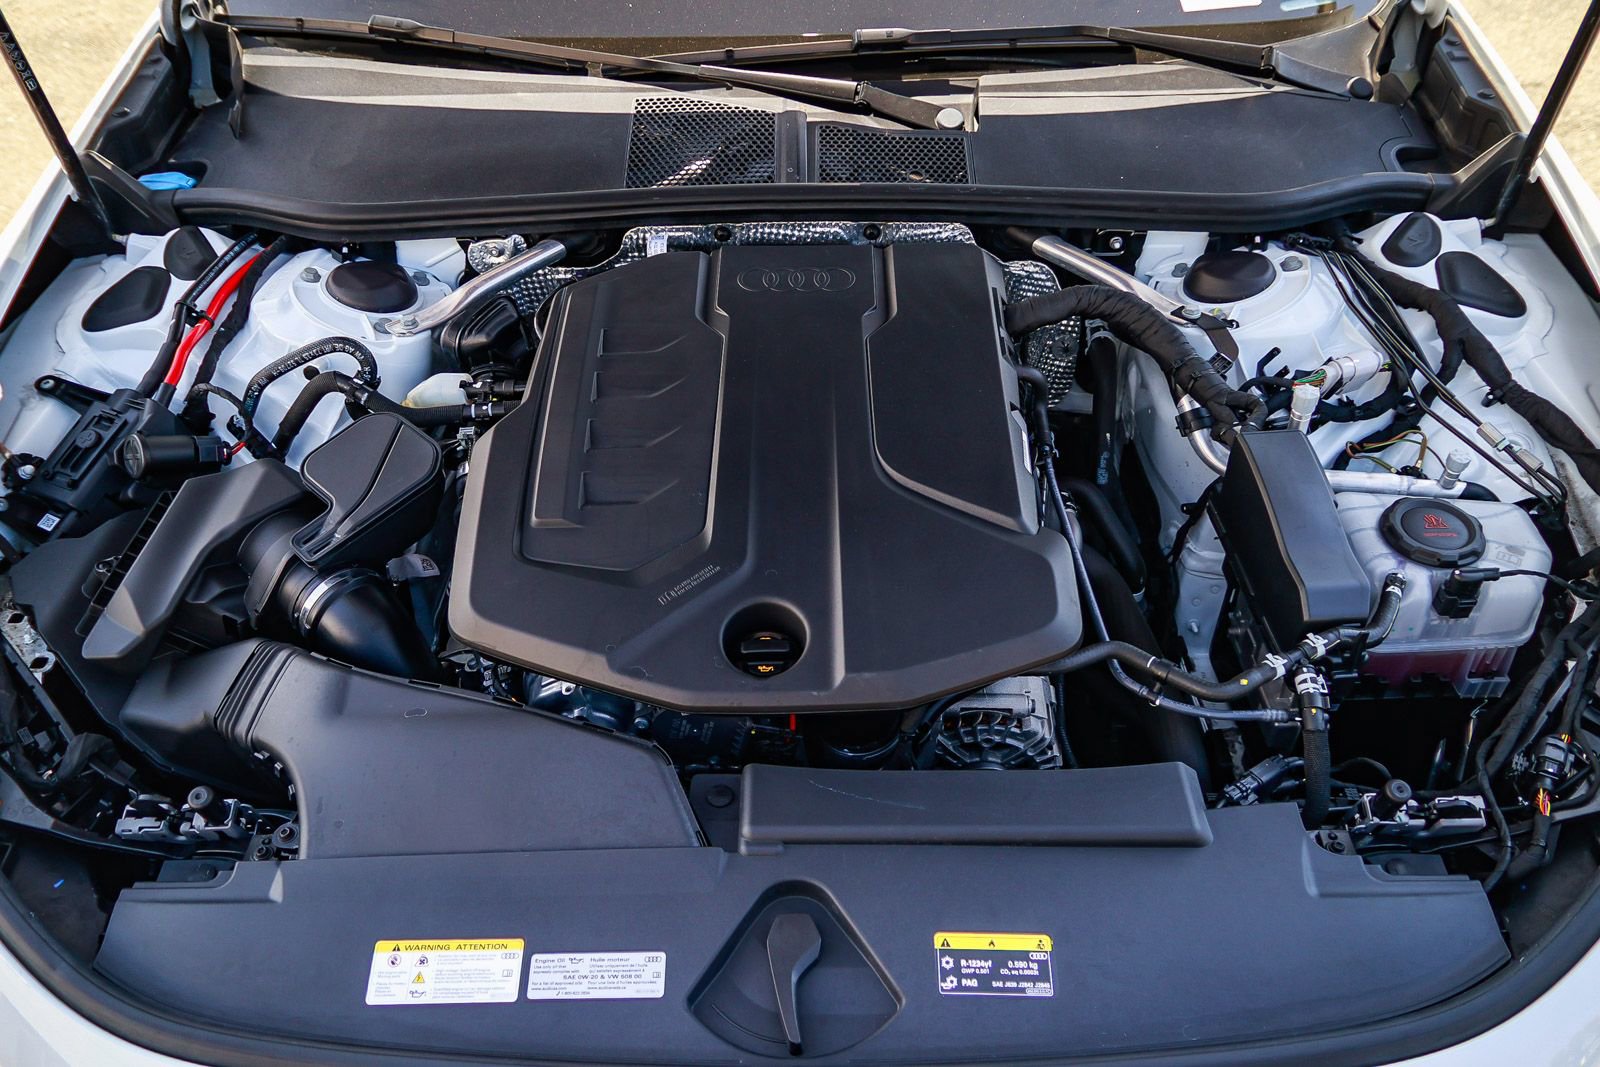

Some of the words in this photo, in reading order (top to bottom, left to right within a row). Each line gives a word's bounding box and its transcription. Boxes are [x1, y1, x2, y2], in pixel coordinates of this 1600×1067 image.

[455, 943, 508, 951] ATTENTION
[960, 959, 992, 968] R-1234yf
[1029, 961, 1039, 970] kg
[961, 978, 978, 987] PAG
